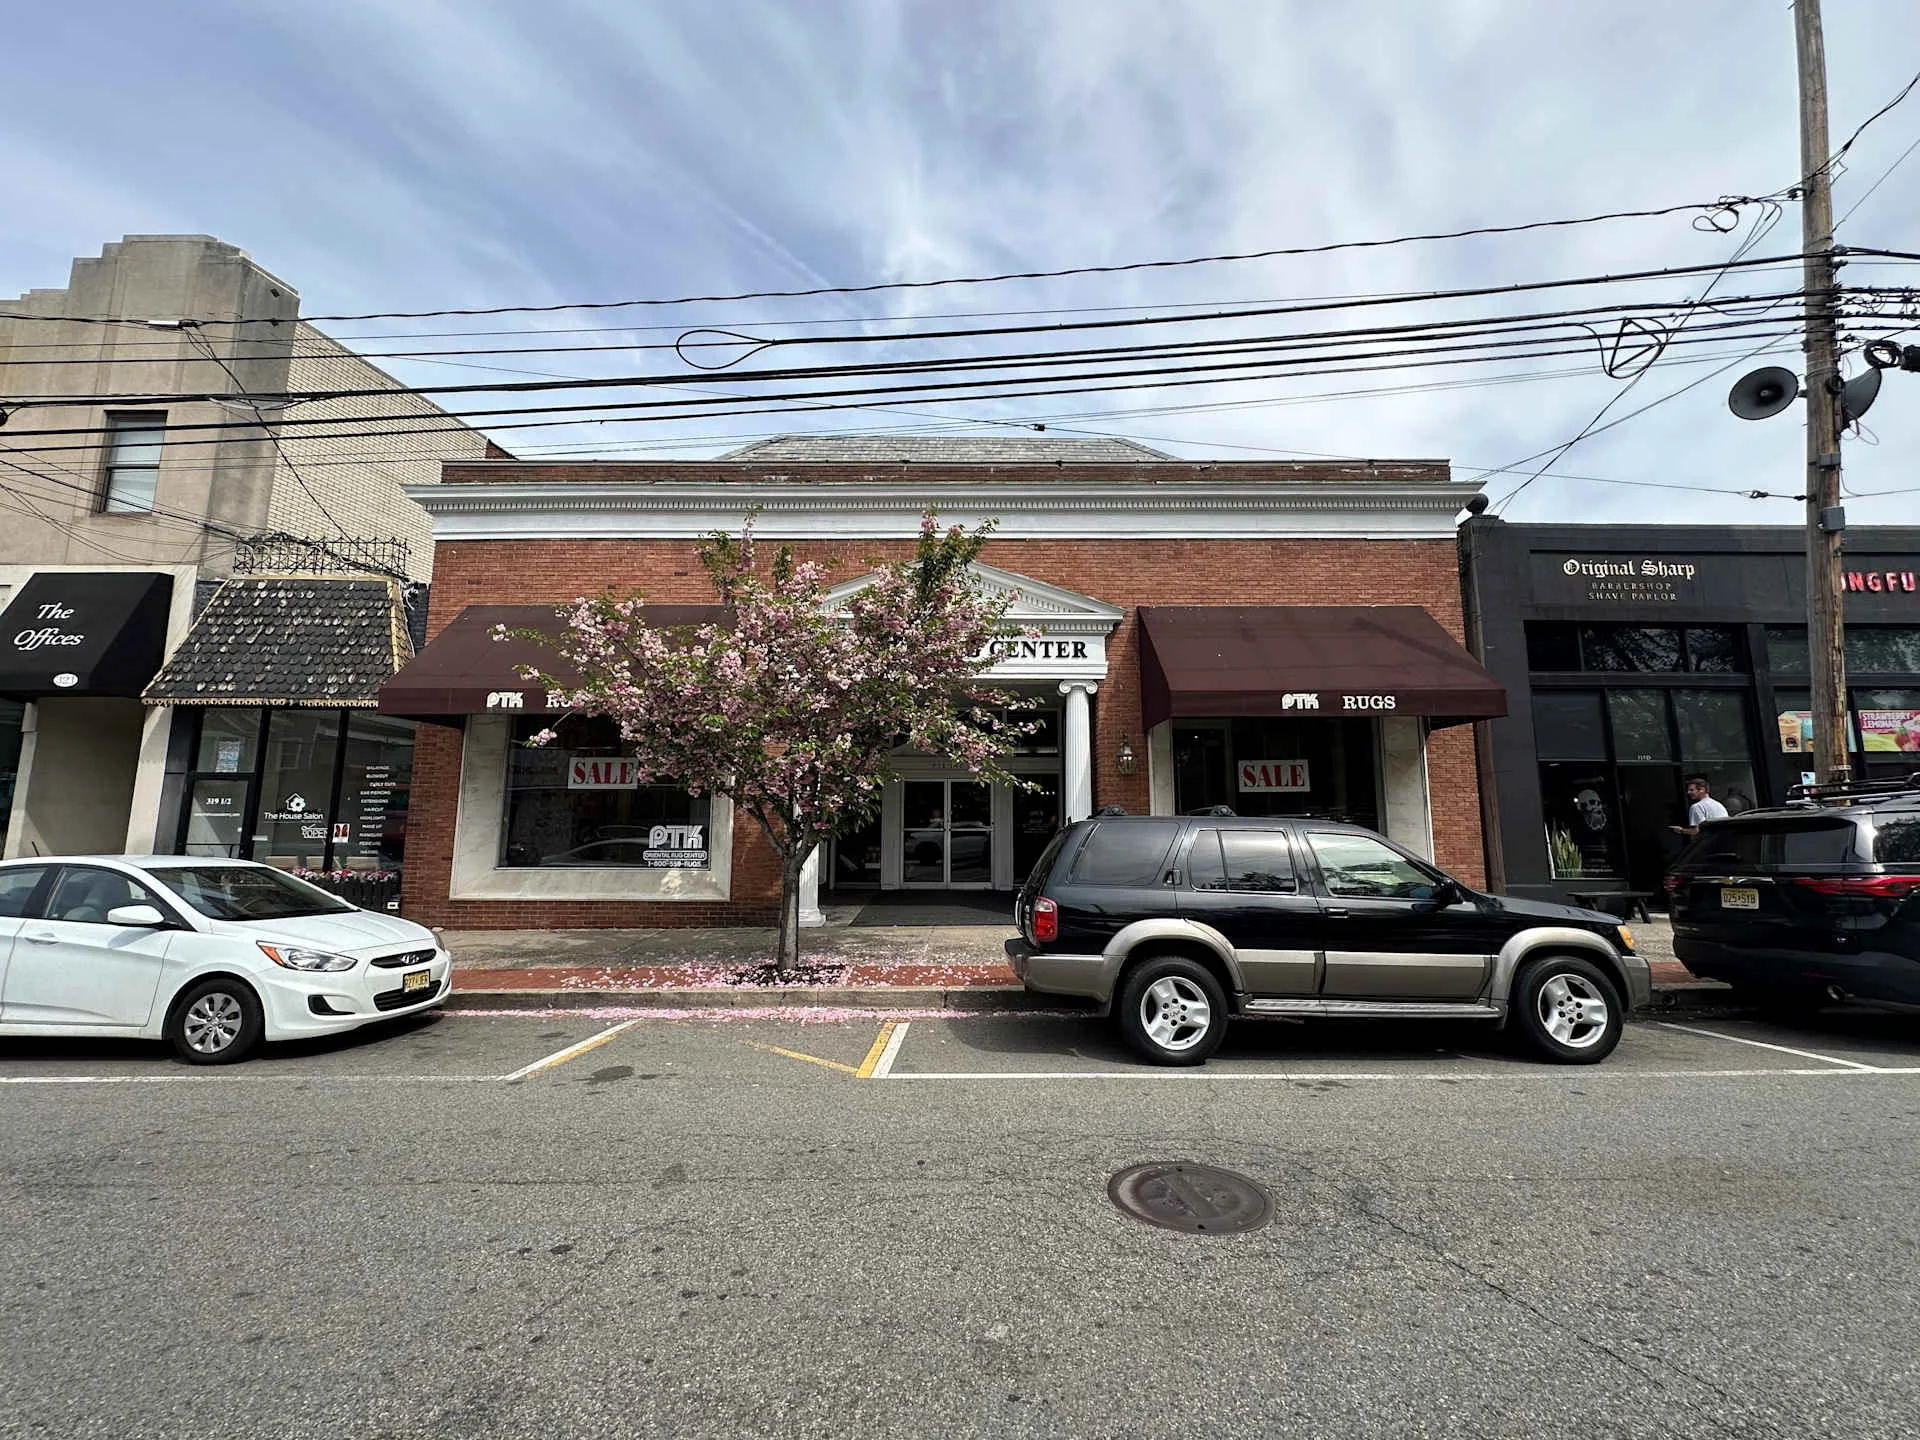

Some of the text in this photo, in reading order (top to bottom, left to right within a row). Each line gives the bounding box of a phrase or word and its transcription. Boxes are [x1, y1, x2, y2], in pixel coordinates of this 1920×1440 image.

[1563, 559, 1695, 580] Original Sharp
[1591, 582, 1672, 590] BARBERSHOP
[1588, 592, 1677, 601] SHAVE PARLOR
[36, 602, 75, 619] The
[13, 627, 84, 651] Offices
[989, 641, 1088, 658] CENTER
[486, 691, 524, 708] PTK
[1281, 693, 1396, 710] PTK RUGS
[1862, 712, 1911, 720] STRAWBERRY
[1862, 720, 1902, 729] LEMONADE
[572, 761, 635, 784] SALE
[1242, 764, 1305, 787] SALE
[264, 812, 324, 820] The House Salon
[648, 825, 703, 849] PTK
